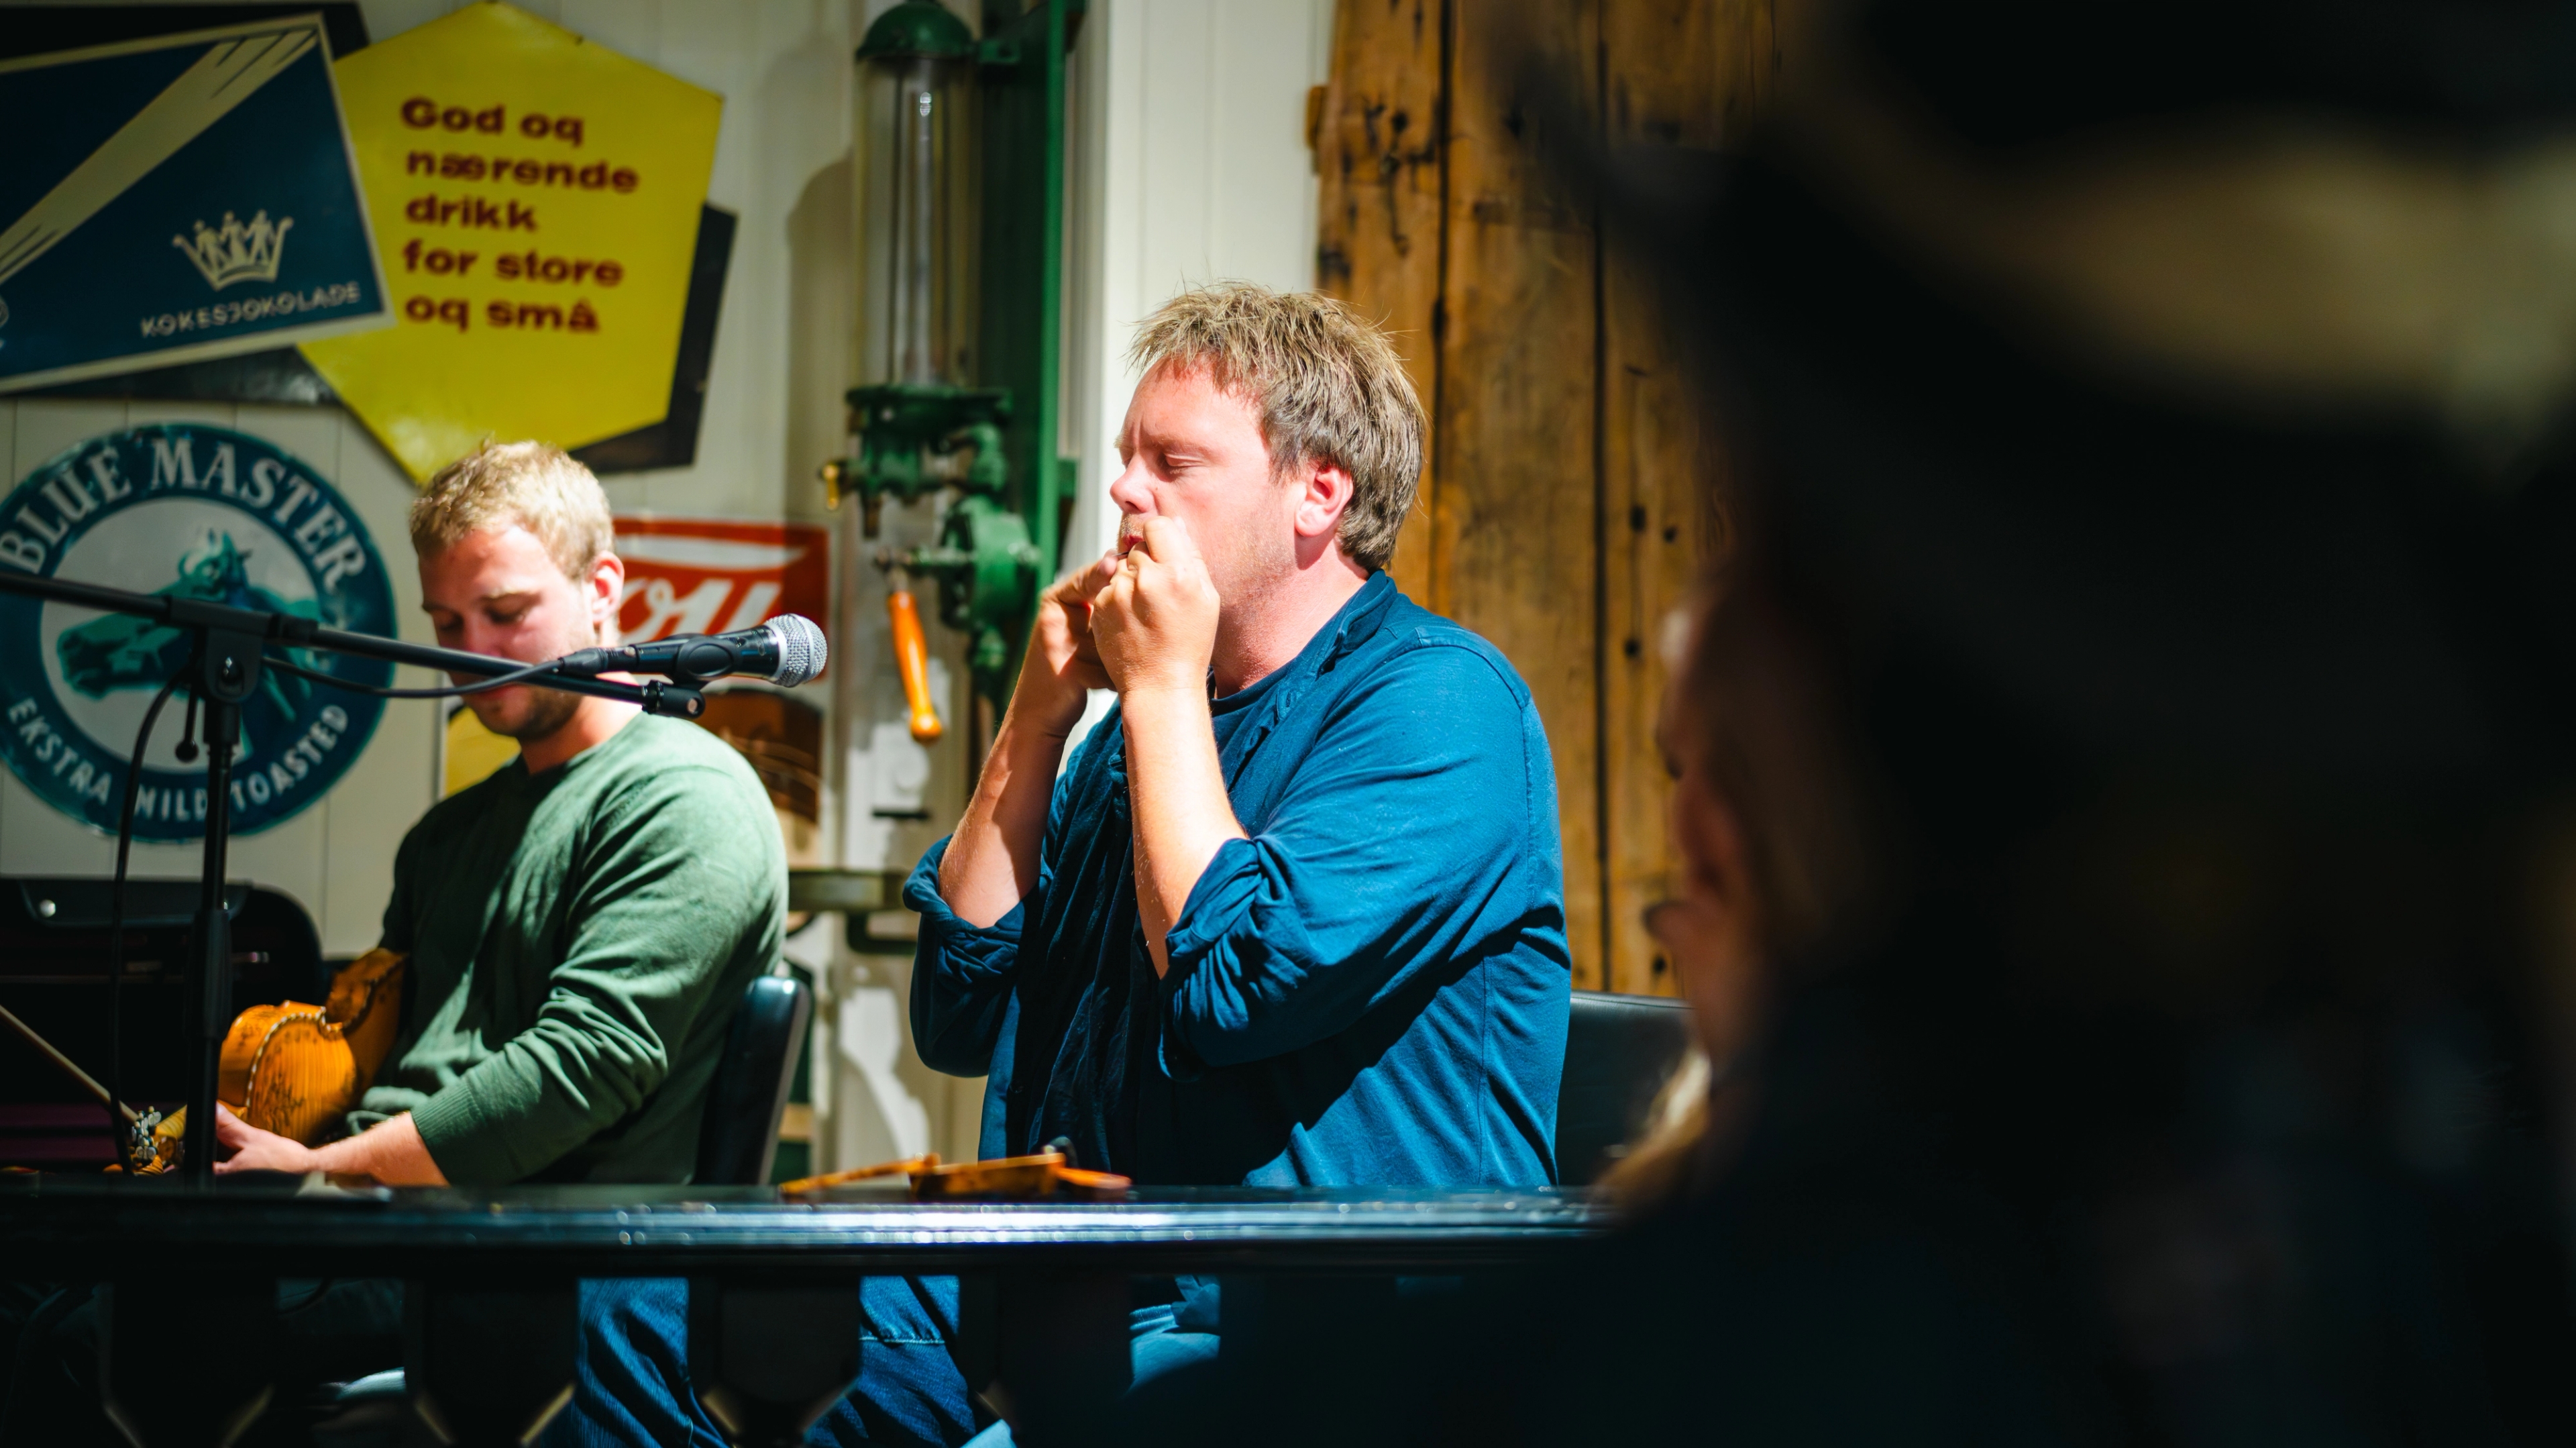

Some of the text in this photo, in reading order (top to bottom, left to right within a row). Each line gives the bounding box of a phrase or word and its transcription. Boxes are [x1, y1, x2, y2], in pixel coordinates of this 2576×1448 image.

[402, 96, 505, 135] God
[407, 150, 640, 194] nærende
[405, 194, 539, 232] drikk
[404, 237, 625, 287] for store
[486, 298, 601, 333] små
[0, 437, 367, 596] BLUE MASTER
[7, 698, 348, 822] EKSTRA MILD TOASTED
